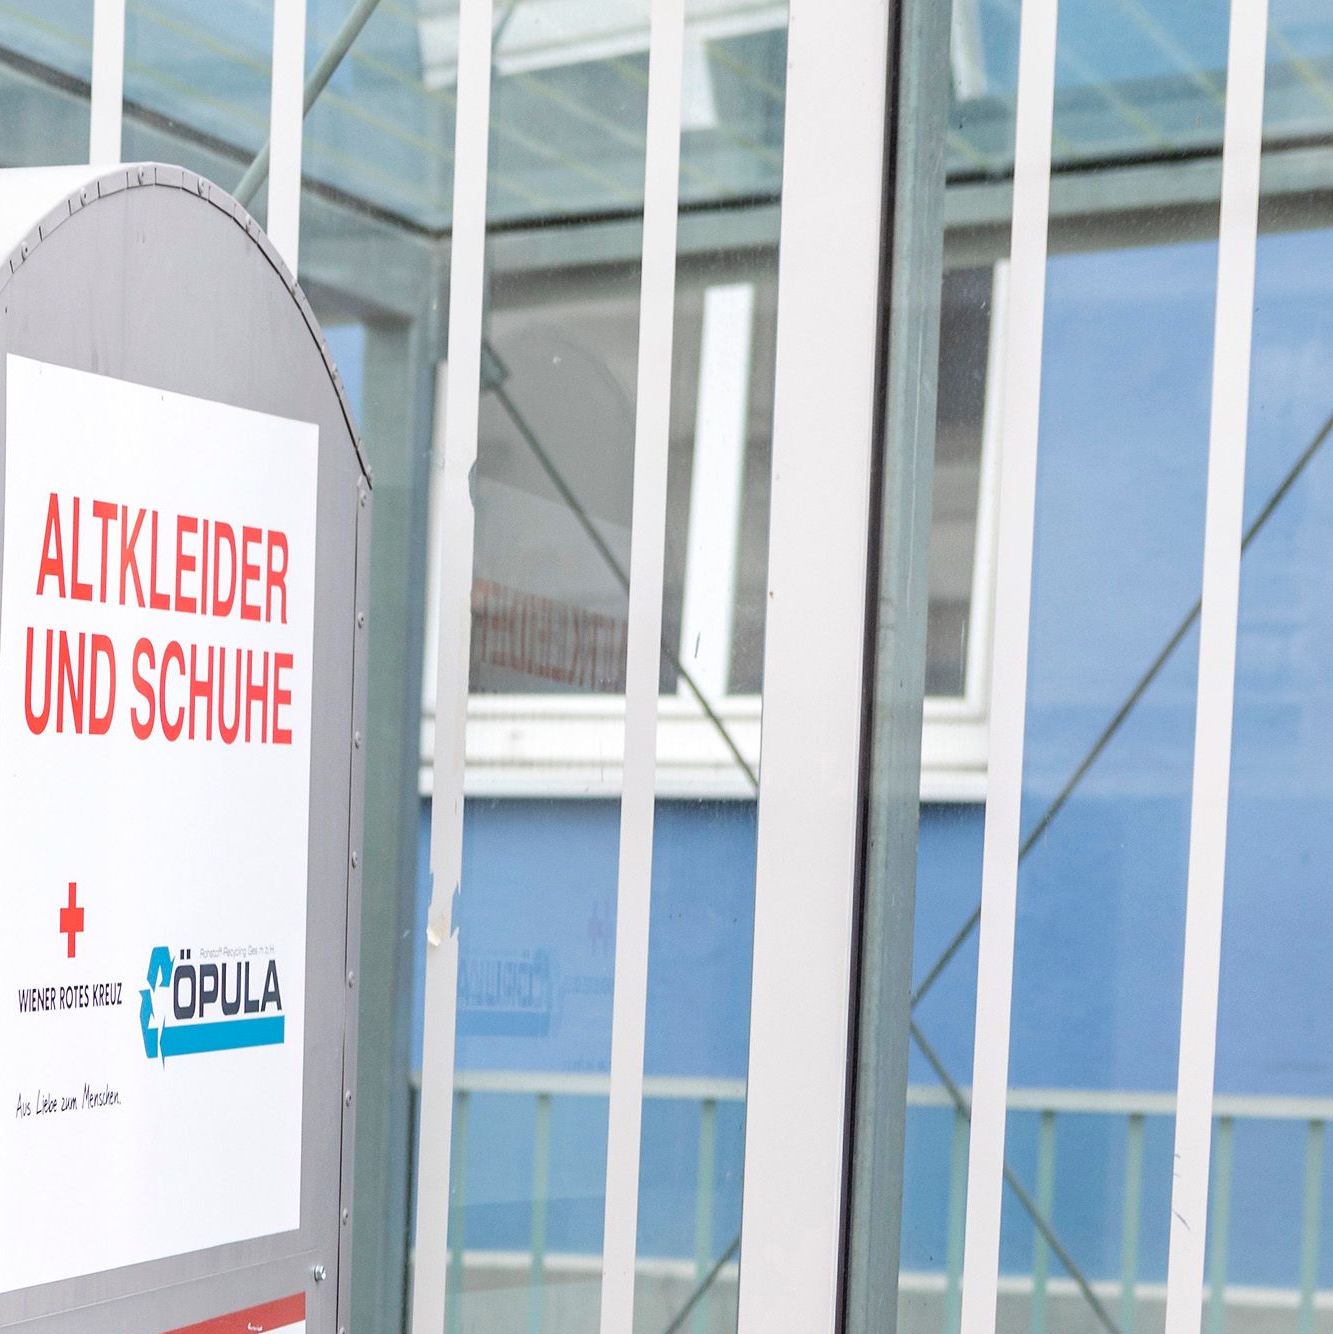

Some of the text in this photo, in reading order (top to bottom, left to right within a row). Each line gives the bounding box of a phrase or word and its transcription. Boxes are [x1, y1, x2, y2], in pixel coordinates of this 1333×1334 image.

[36, 492, 289, 625] ALTKLEIDER
[24, 626, 294, 745] UND SCHUHE
[18, 982, 123, 1013] WIENER ROTES KREUZ
[173, 948, 282, 1020] ÖPULA
[15, 1092, 32, 1119] Aus
[36, 1089, 58, 1116] Liebe
[61, 1094, 78, 1112] zum
